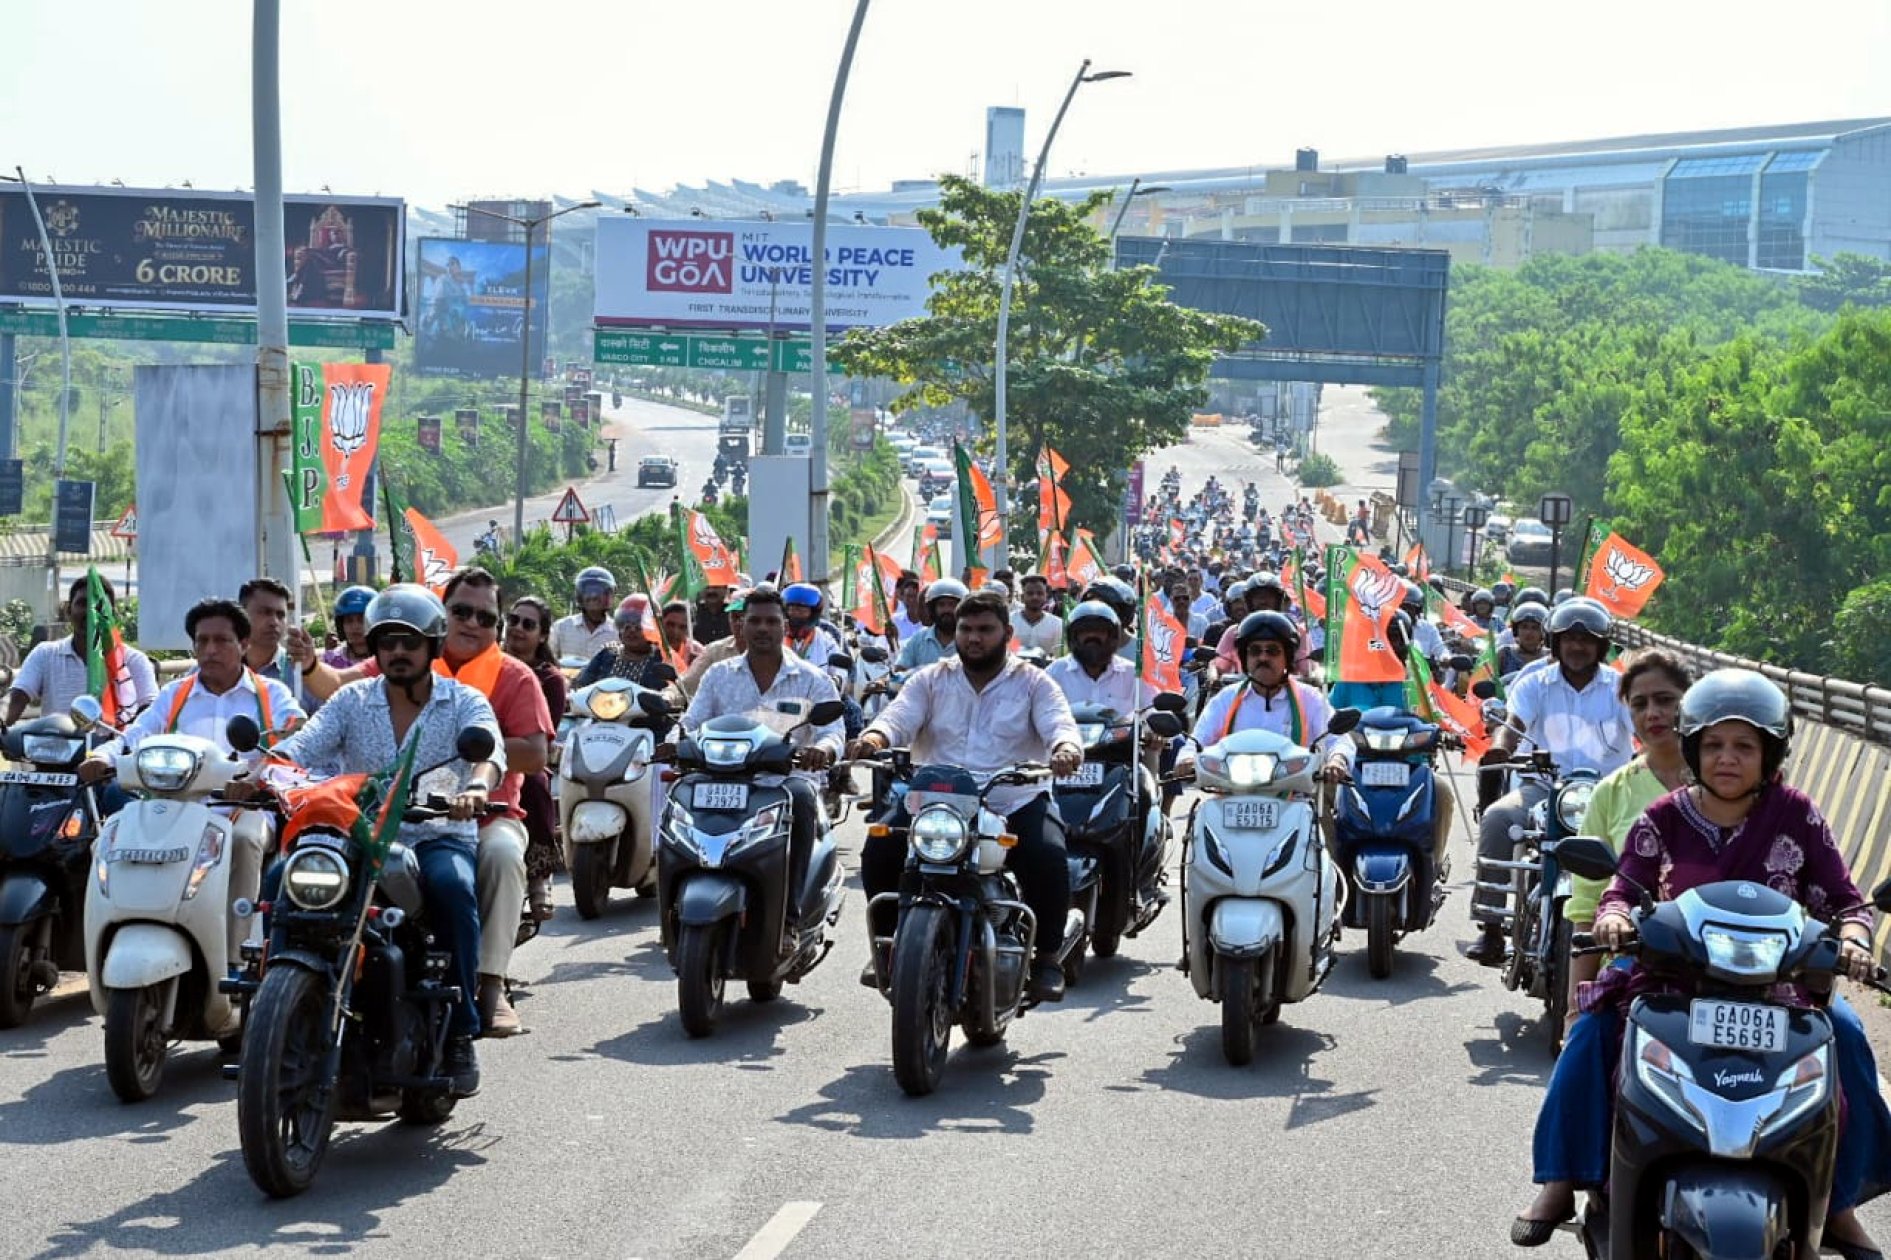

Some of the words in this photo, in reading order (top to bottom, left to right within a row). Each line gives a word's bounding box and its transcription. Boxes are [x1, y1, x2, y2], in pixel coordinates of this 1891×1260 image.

[145, 206, 235, 225] MAJESTIC
[134, 220, 248, 242] MILLIONAIRE
[655, 237, 728, 260] WPU
[838, 248, 914, 267] PEACE
[36, 253, 87, 267] PIDE
[136, 258, 155, 283] 6
[159, 264, 240, 286] CRORE
[689, 303, 713, 313] FIRST
[1715, 1005, 1775, 1029] GA06A
[1713, 1023, 1775, 1049] E5693
[1713, 1067, 1765, 1088] Yagnesh
